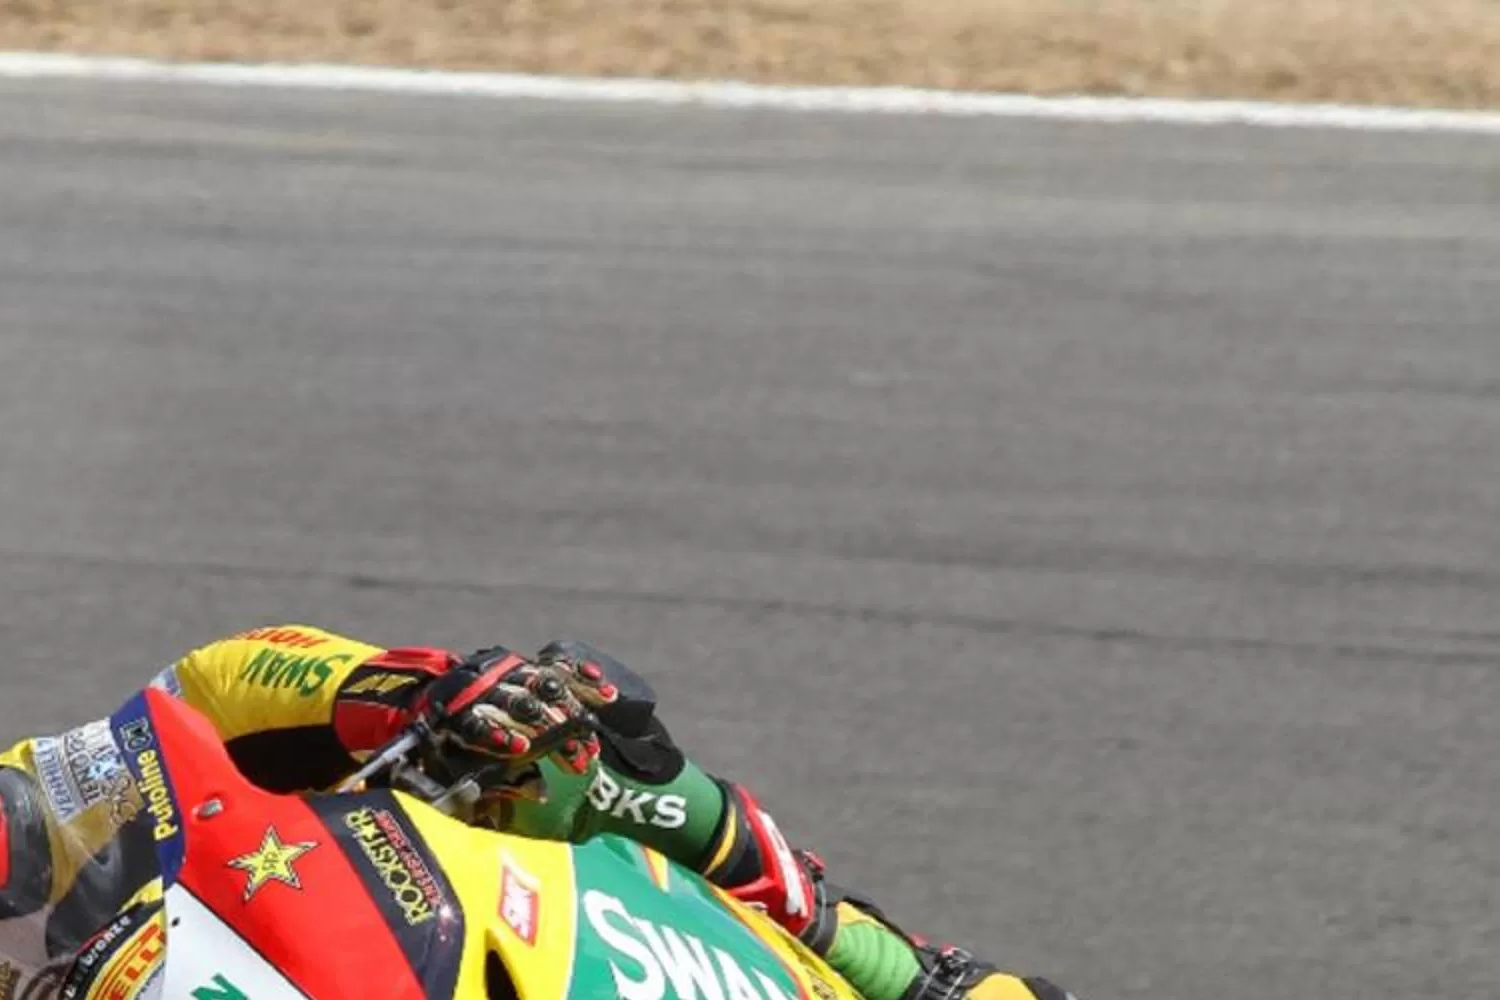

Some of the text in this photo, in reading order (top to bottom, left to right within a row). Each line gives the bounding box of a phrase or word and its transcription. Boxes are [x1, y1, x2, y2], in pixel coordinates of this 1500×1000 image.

[241, 648, 353, 696] SWAN
[137, 749, 179, 841] Putoline
[585, 769, 688, 830] BKS
